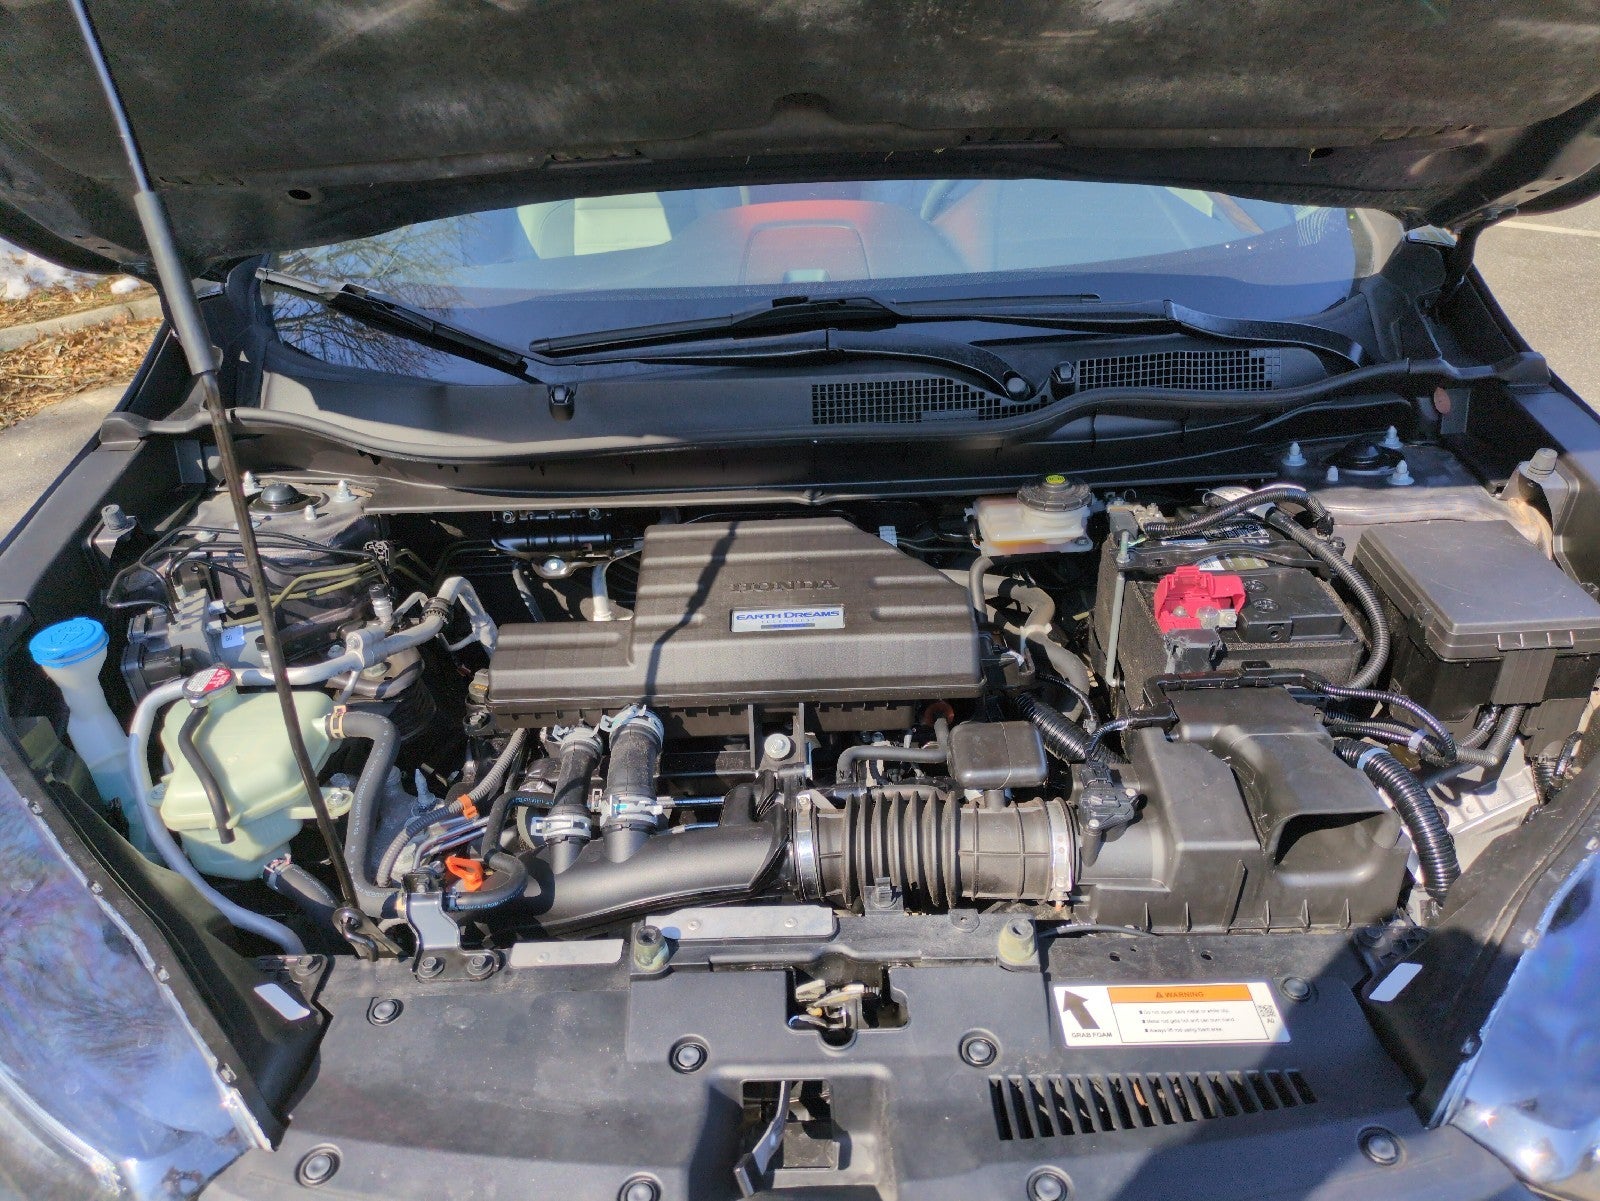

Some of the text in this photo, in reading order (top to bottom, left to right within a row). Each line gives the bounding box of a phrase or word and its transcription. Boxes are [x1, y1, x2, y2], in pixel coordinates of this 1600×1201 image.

[730, 580, 840, 592] HONDA
[736, 610, 840, 620] EARTH DREAMS
